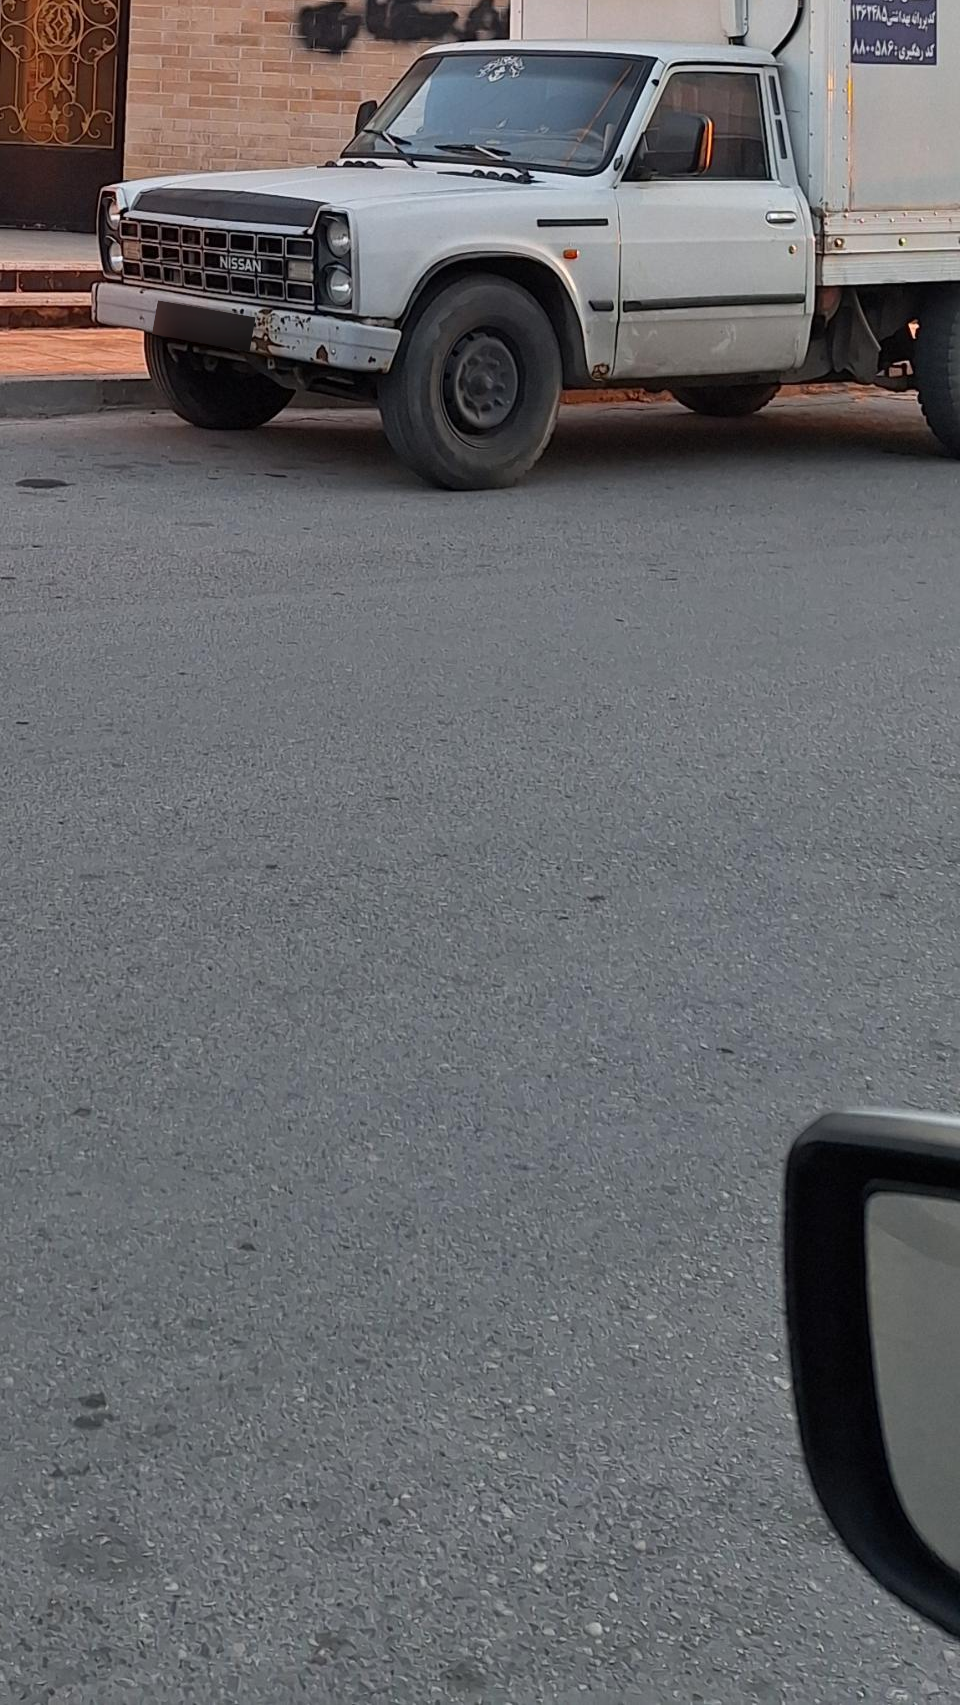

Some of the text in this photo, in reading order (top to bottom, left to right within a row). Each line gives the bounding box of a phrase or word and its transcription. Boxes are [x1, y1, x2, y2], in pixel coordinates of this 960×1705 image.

[911, 9, 928, 32] پروانه
[927, 10, 936, 24] کد
[925, 43, 935, 58] کد
[219, 256, 263, 274] NISSAN
